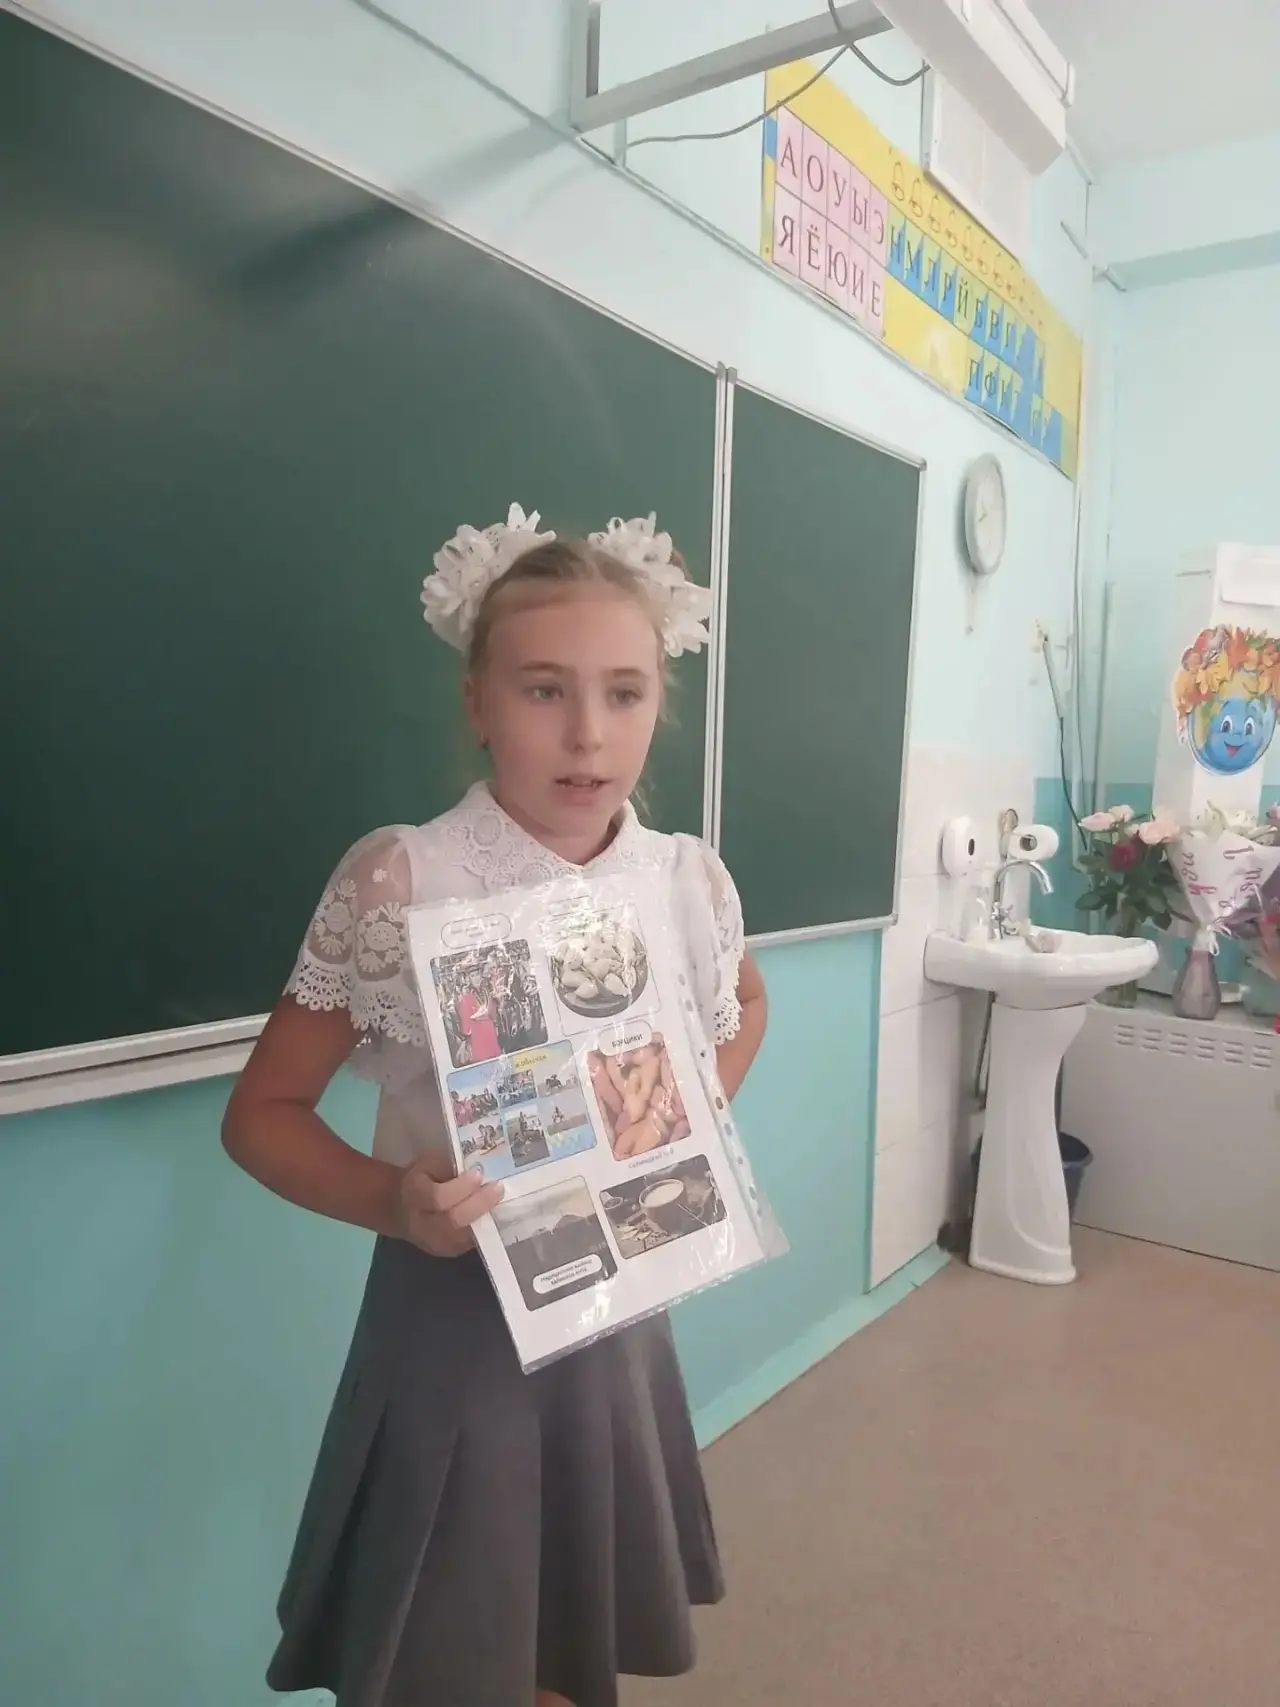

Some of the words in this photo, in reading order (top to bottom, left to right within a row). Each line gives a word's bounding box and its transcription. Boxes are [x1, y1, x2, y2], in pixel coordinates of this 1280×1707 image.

[780, 137, 798, 178] А
[853, 187, 868, 231] Ы
[779, 215, 795, 256] Я
[807, 224, 820, 271] Ё
[827, 243, 848, 287] Ю
